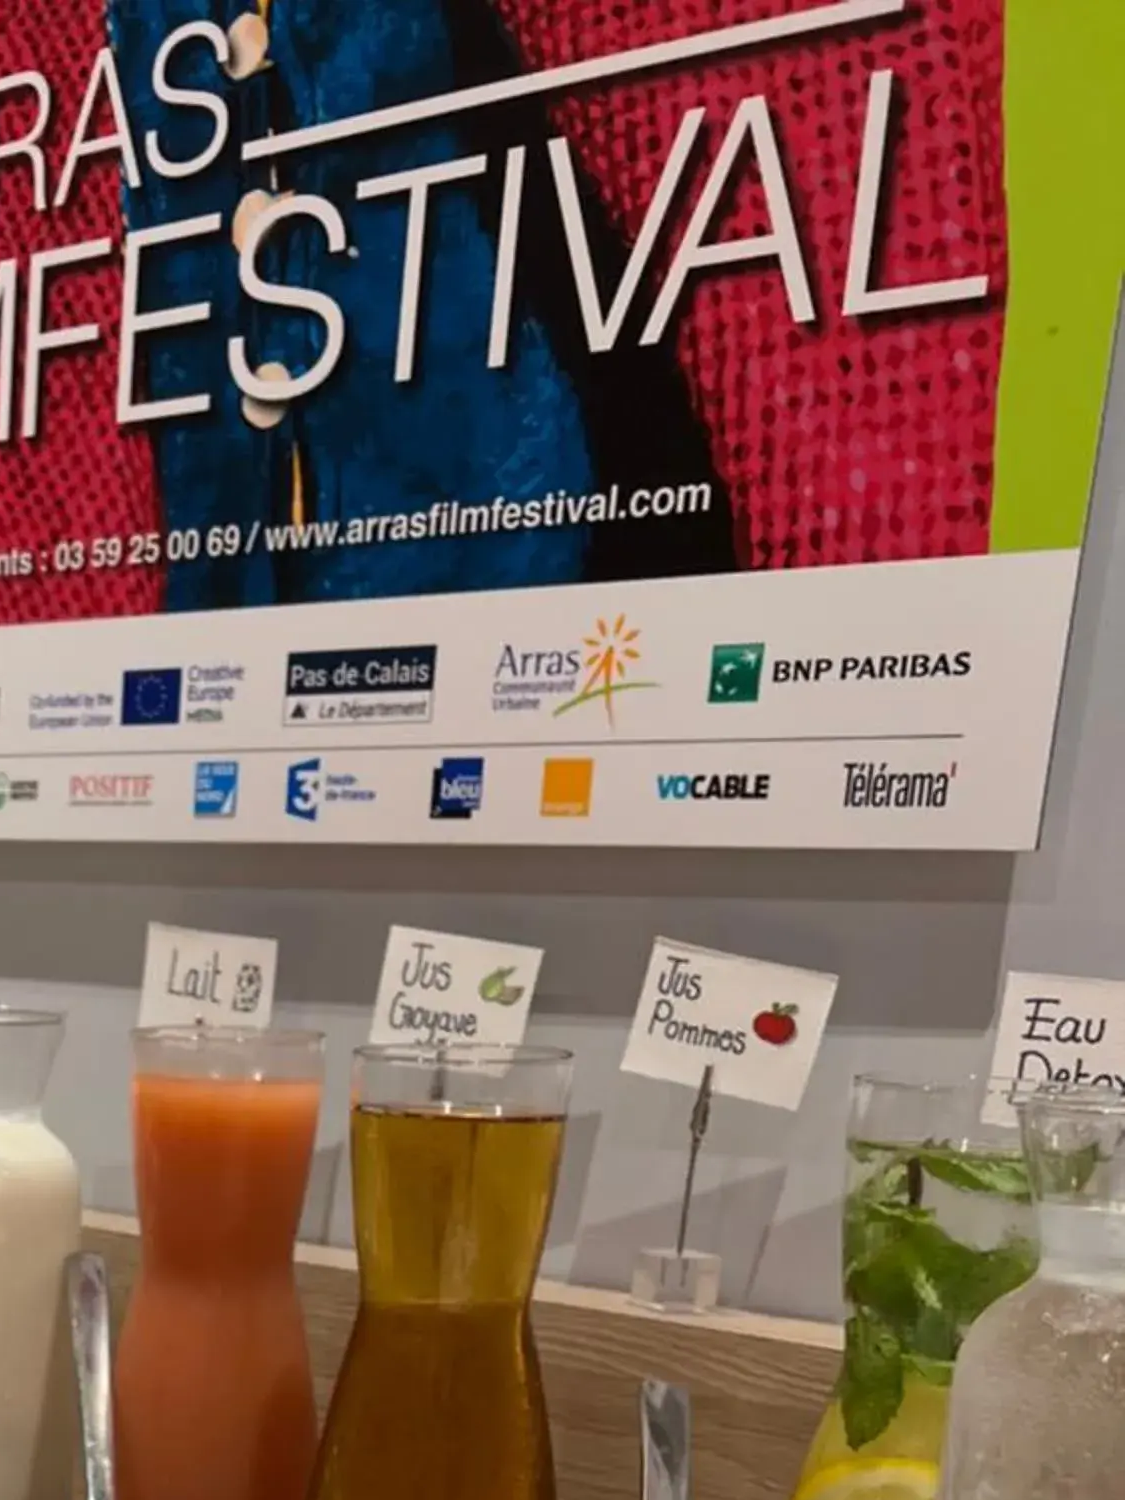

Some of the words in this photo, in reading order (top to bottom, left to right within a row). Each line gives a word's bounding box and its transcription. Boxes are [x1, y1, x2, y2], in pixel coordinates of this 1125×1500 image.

[53, 540, 84, 573] 03
[91, 537, 121, 568] 59
[127, 533, 160, 565] 25
[167, 529, 199, 561] 00
[206, 524, 239, 557] 69
[265, 482, 712, 551] www.arrasfilmfestival.com
[290, 664, 328, 689] Pas
[332, 660, 358, 686] de
[364, 656, 430, 684] Calais
[495, 645, 581, 678] Arras
[772, 658, 833, 683] BNP
[839, 651, 972, 680] PARIBAS
[69, 774, 155, 799] POSITIF
[657, 774, 770, 800] VOCABLE
[167, 946, 222, 1004] Lait
[401, 941, 452, 992] Jus
[658, 956, 703, 1001] Jus
[389, 990, 478, 1046] Goyave
[647, 999, 746, 1056] Pommes
[1020, 997, 1107, 1045] Eau
